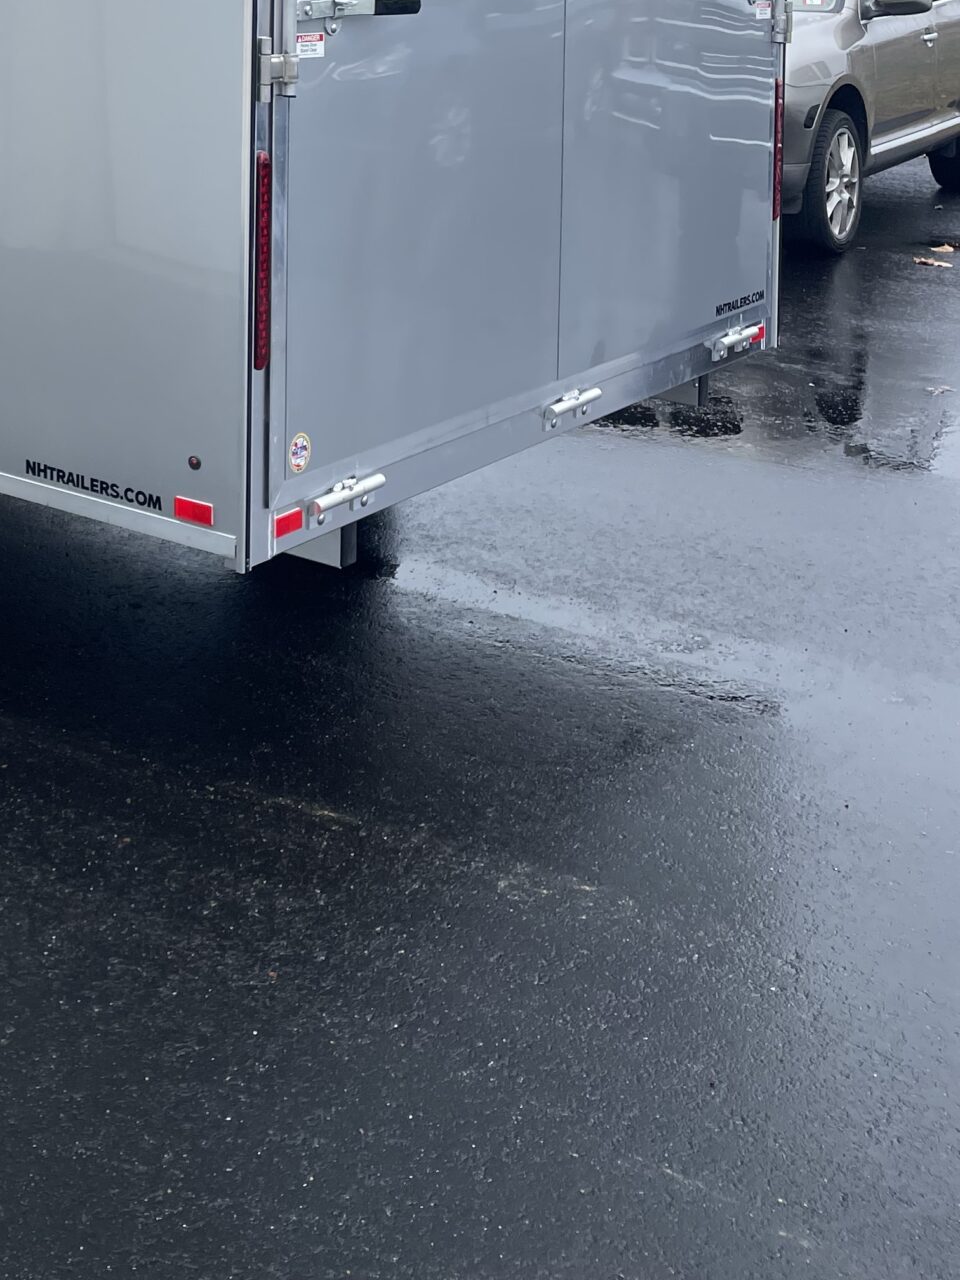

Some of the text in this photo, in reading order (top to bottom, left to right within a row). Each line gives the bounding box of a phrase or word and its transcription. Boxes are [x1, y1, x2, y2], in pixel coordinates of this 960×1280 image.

[301, 34, 320, 42] DANGER
[715, 289, 765, 317] NHTRAILERS.COM
[25, 459, 163, 512] NHTRAILERS.COM
